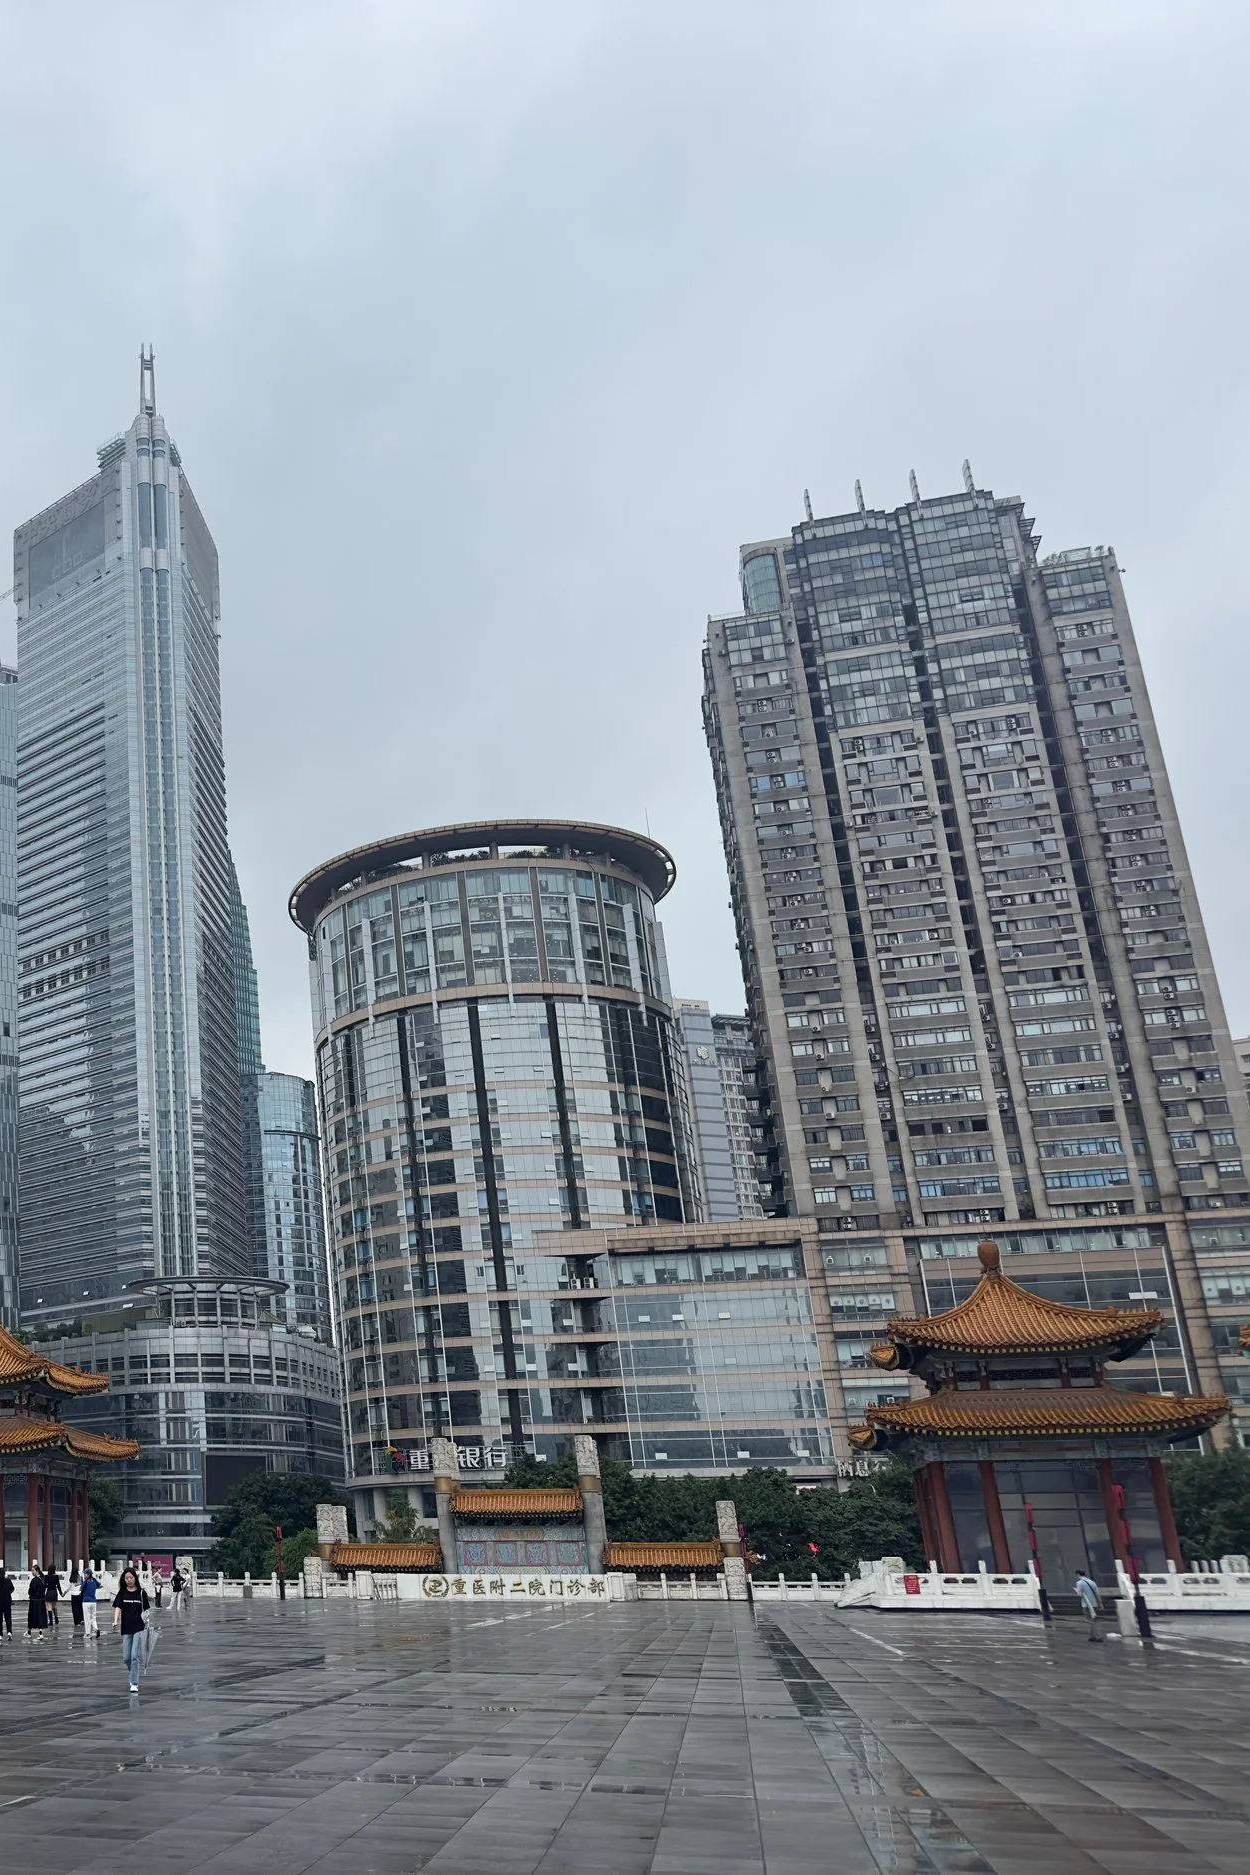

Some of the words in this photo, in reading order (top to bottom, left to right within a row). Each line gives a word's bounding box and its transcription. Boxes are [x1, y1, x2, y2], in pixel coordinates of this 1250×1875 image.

[409, 1446, 508, 1470] 重银行
[451, 1578, 605, 1597] 重医附二院门诊部
